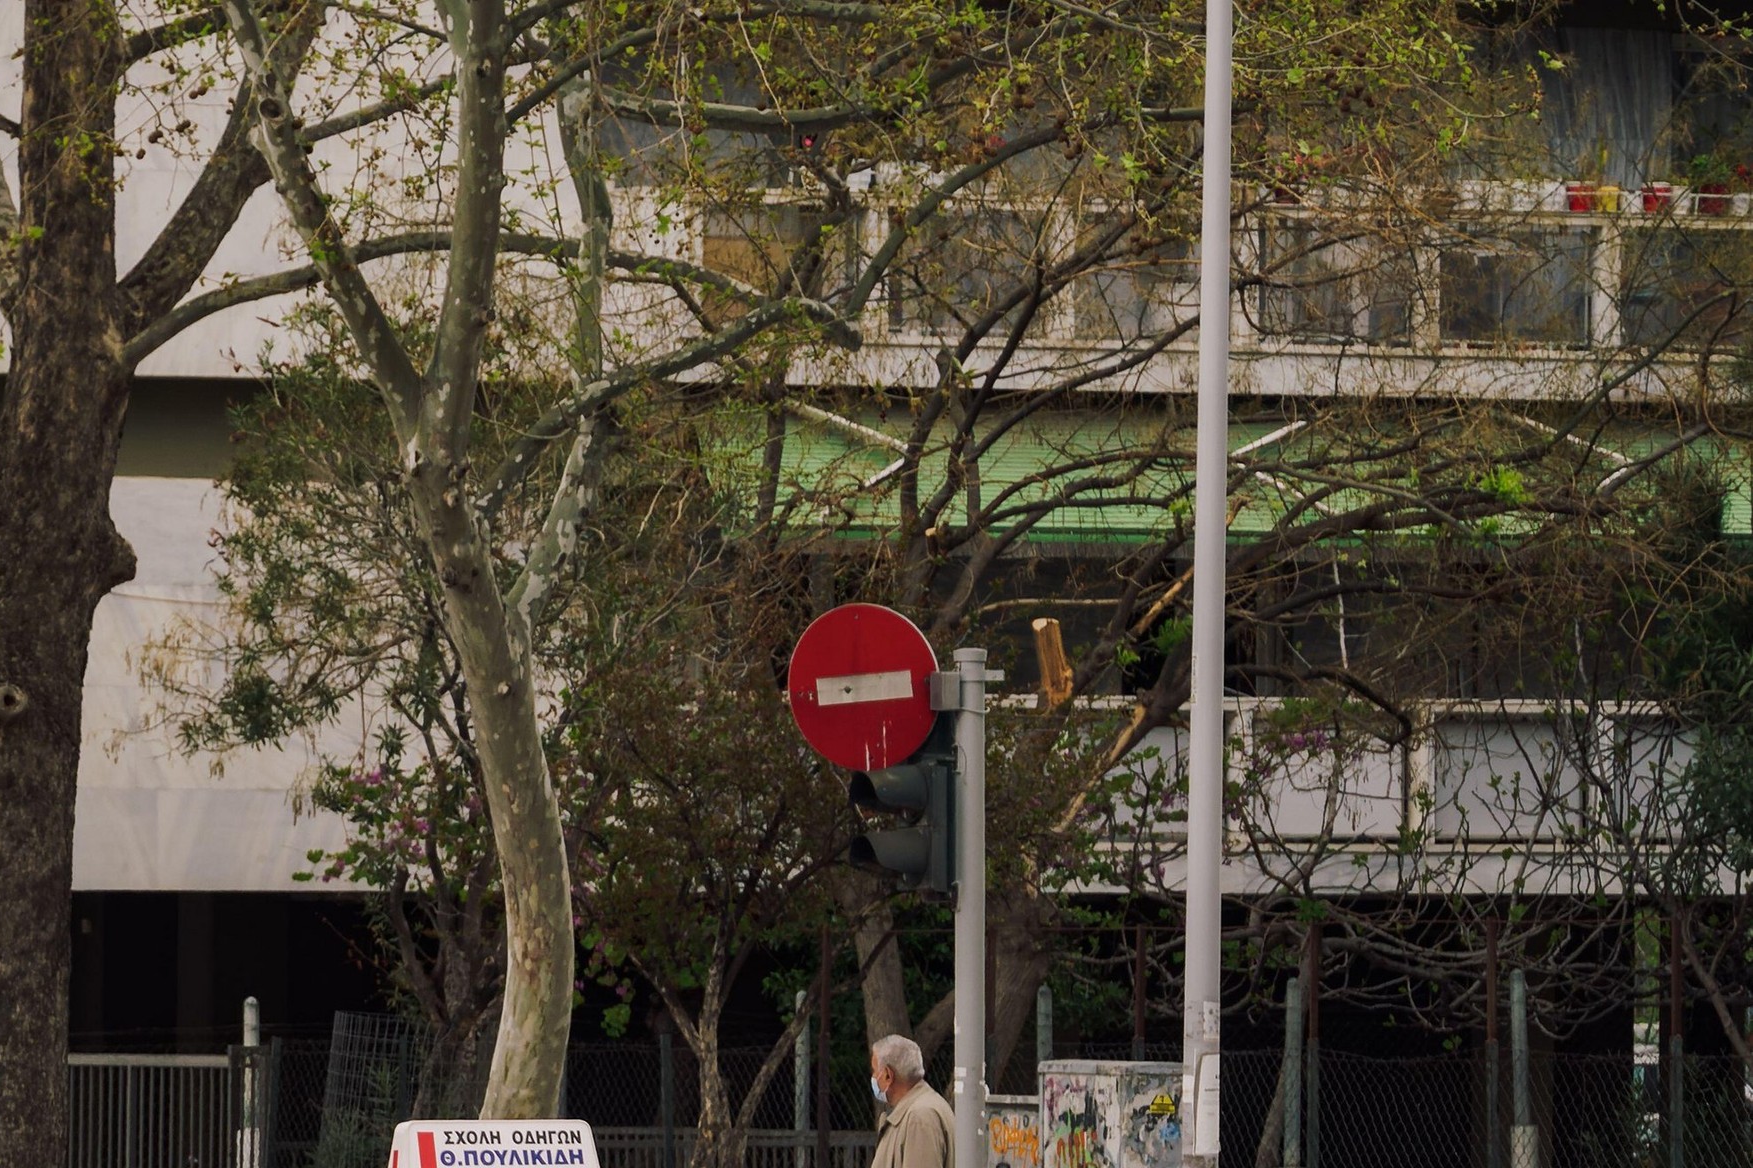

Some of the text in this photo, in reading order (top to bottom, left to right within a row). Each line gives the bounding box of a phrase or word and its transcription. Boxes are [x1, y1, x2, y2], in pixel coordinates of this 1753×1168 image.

[444, 1130, 582, 1145] ΣΧΟΛΗ ΟΔΗΓΩΝ
[440, 1148, 585, 1166] Θ.ΠΟΥΛΙΚΙΔΗ
